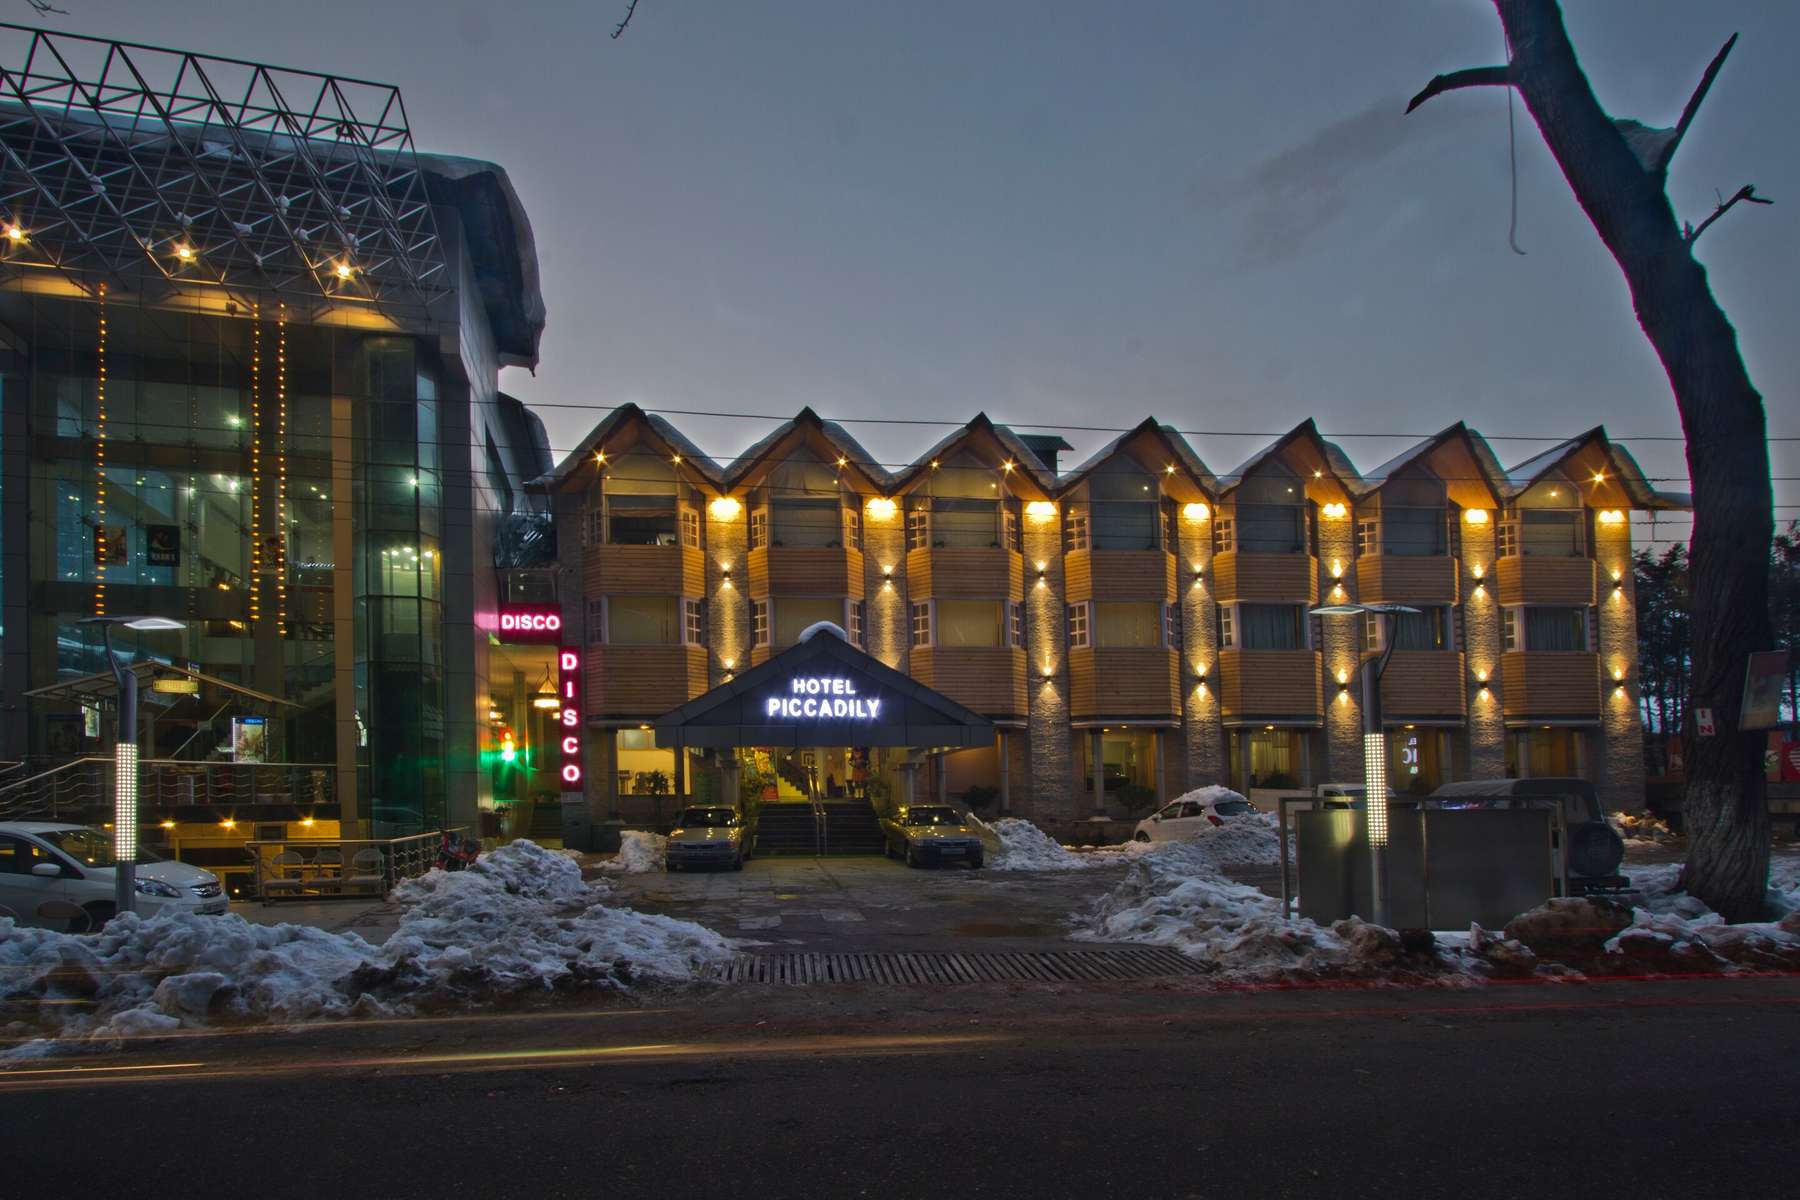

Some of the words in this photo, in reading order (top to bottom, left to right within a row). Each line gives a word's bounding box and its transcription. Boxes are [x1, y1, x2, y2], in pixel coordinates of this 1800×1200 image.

[501, 615, 561, 630] DISCO
[793, 678, 856, 695] HOTEL
[767, 698, 880, 718] PICCADILY
[561, 653, 581, 782] DISCO
